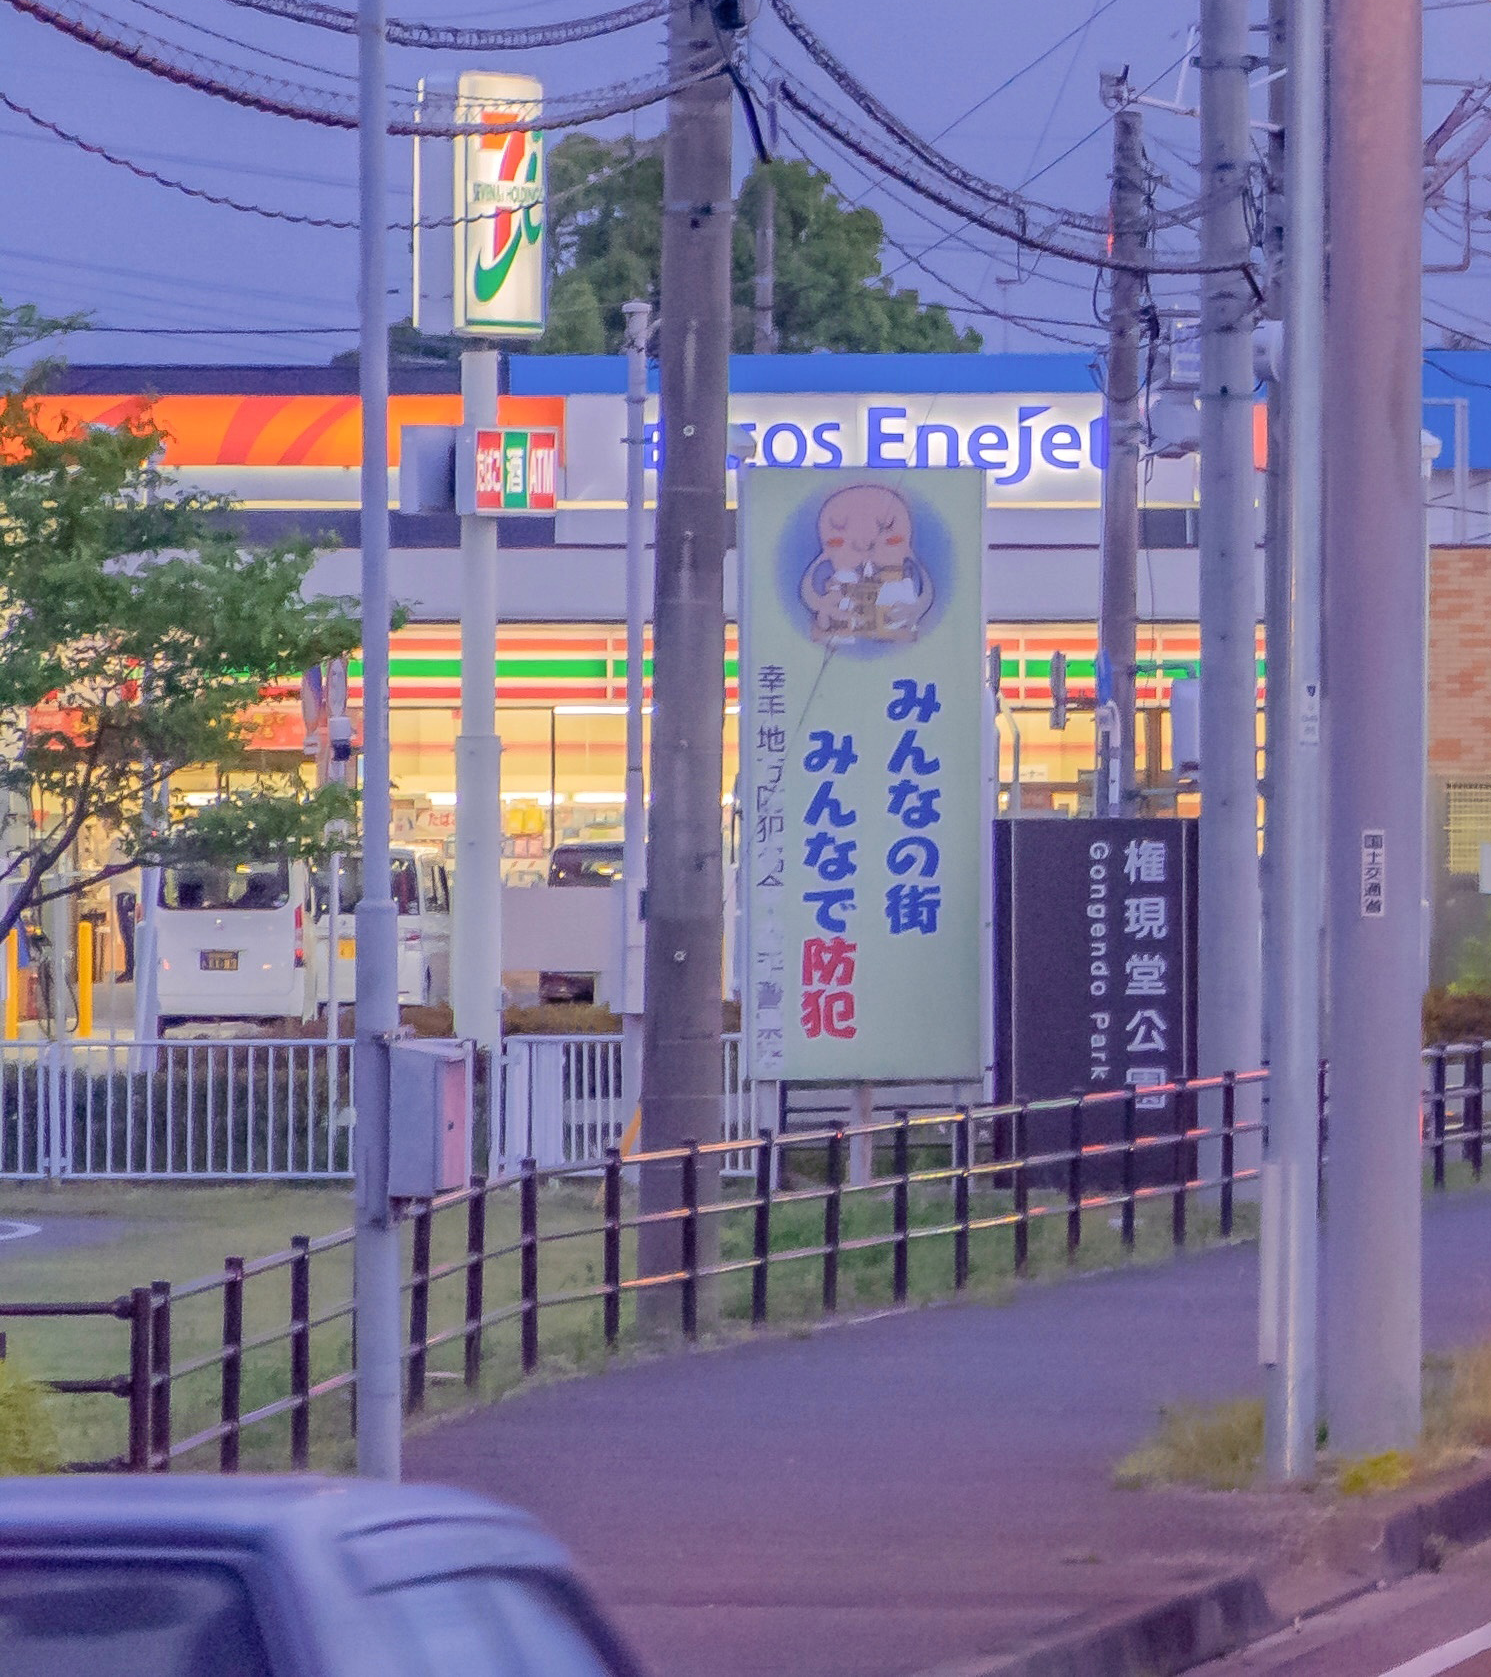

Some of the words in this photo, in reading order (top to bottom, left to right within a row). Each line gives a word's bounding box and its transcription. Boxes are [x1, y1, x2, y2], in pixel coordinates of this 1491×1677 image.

[530, 449, 556, 494] ATM
[800, 730, 859, 1041] みんなで防犯
[884, 679, 942, 937] みんなの街
[1089, 1011, 1111, 1081] Park
[1123, 839, 1168, 1109] 権現堂公園
